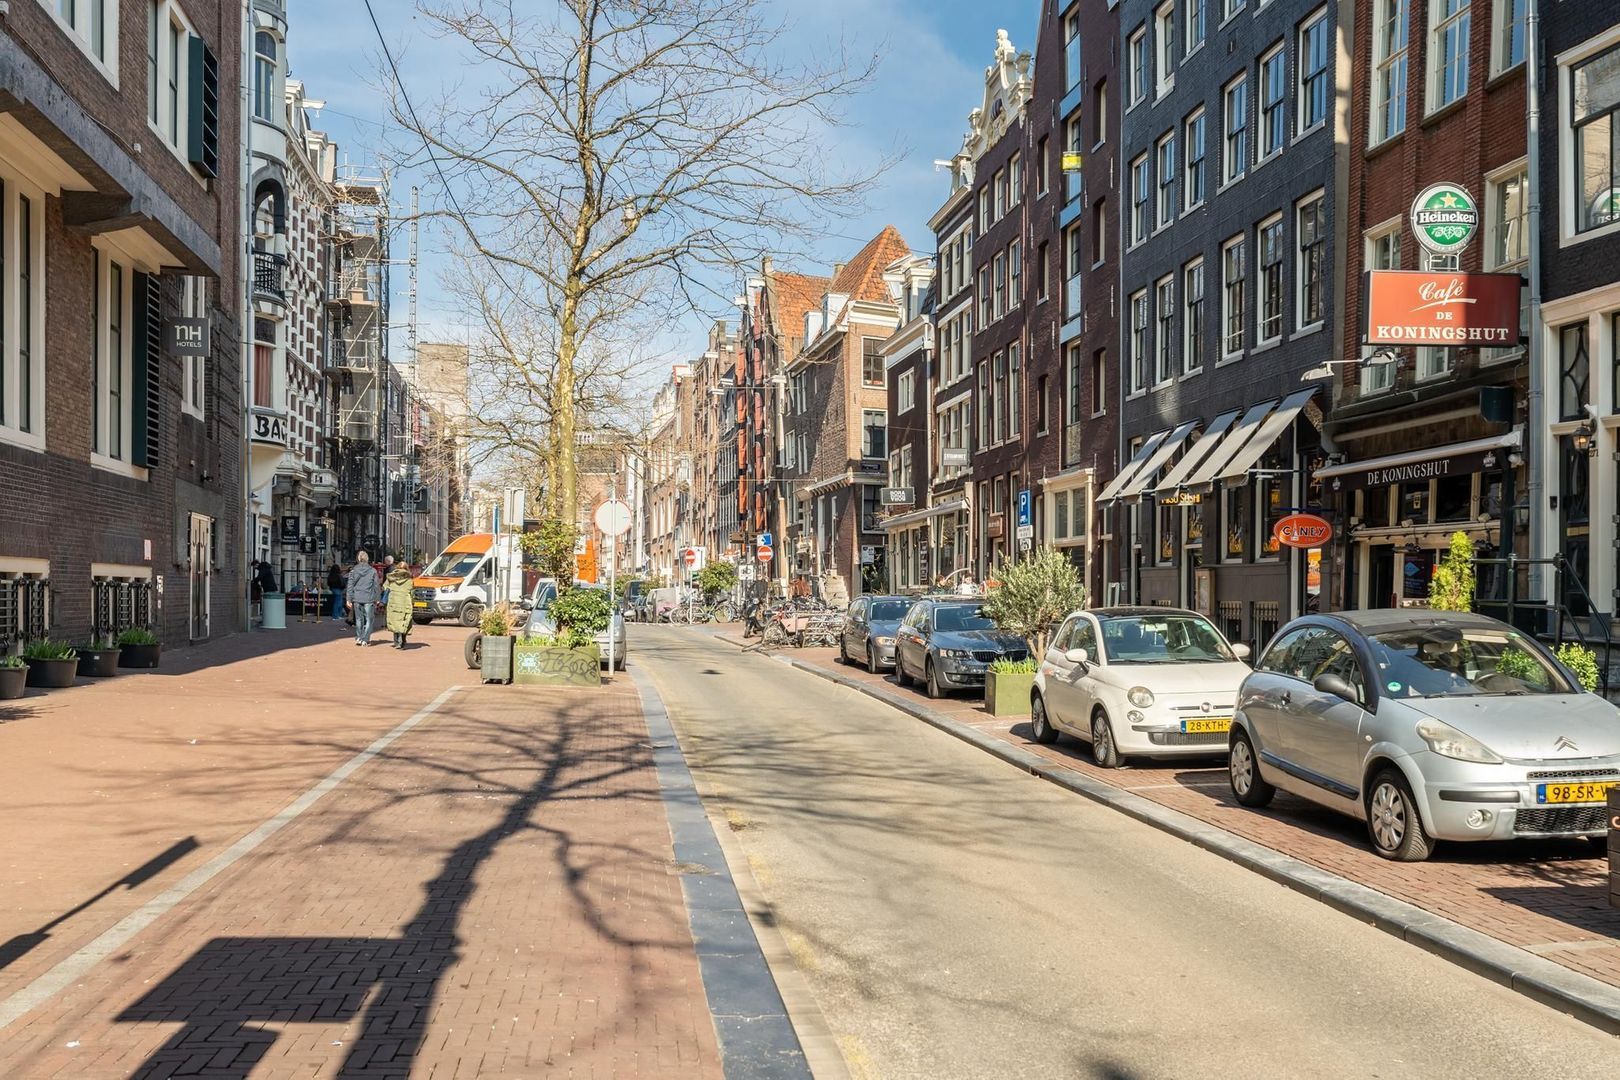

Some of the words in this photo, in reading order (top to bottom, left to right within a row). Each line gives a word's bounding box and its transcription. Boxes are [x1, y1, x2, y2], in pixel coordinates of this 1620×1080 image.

[1418, 211, 1476, 224] Heineken
[1418, 278, 1464, 306] Café
[1436, 311, 1453, 321] DE
[1376, 326, 1509, 341] KONINGSHUT
[1367, 472, 1380, 486] DE
[1382, 459, 1450, 484] KONINGSHUT
[1020, 494, 1027, 512] P
